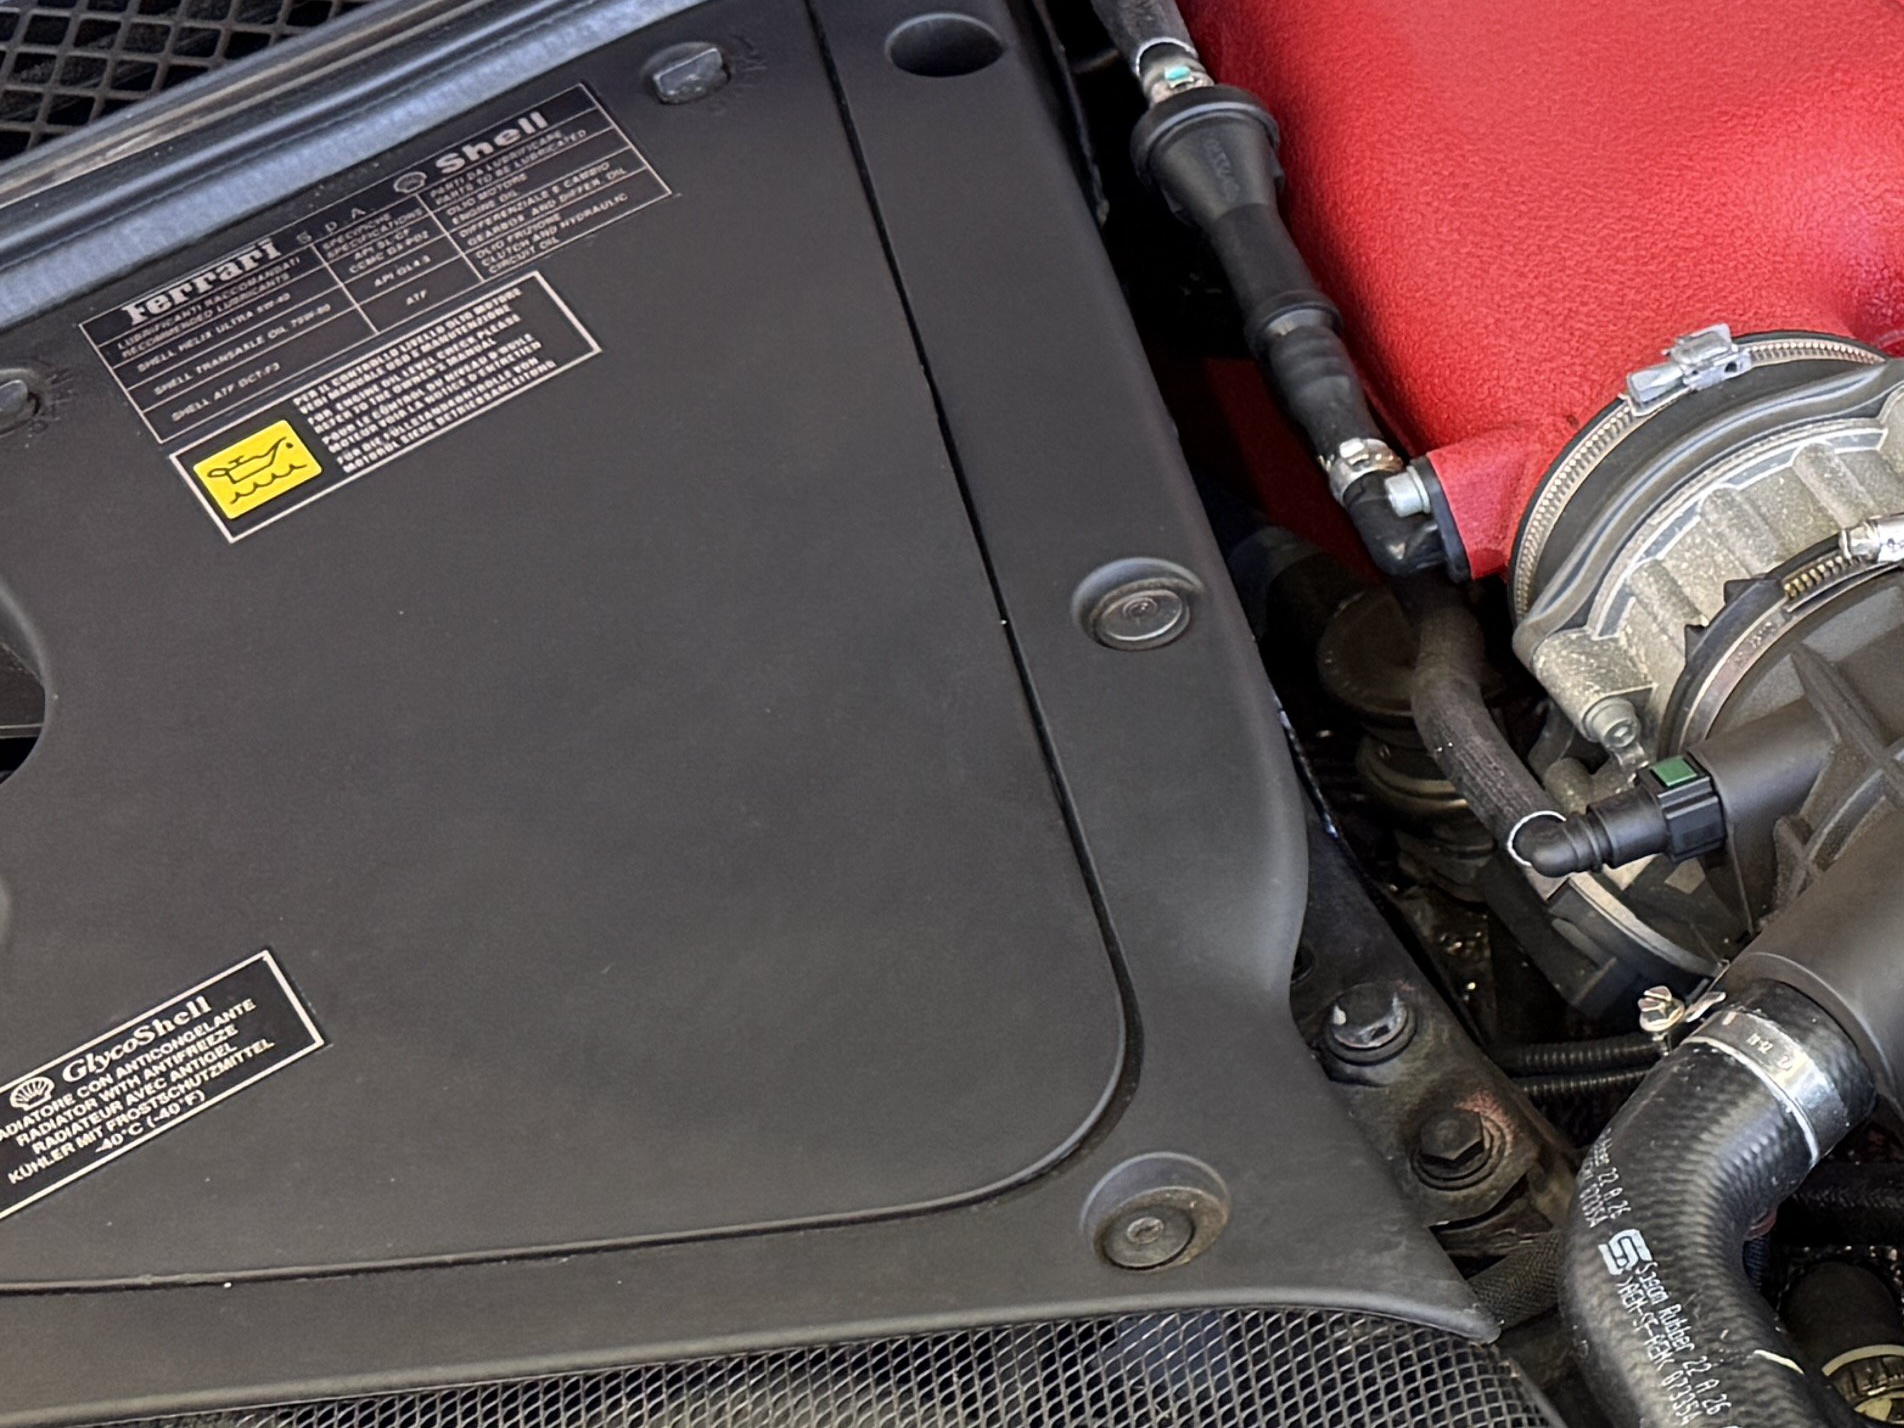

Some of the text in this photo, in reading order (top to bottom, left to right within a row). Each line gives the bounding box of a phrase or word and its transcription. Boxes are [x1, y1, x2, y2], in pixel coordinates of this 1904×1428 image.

[123, 238, 279, 324] Ferrari
[435, 112, 547, 173] Shell
[136, 349, 176, 372] SHELL
[215, 310, 254, 334] ULTRA
[153, 372, 192, 395] SHELL
[0, 999, 255, 1139] ADIATORE CON ANTICONGELANTE
[16, 1024, 238, 1146] RADIATOR WITH ANTIFREEZE
[62, 996, 210, 1082] GlycoShell
[7, 1039, 273, 1184] KÜHLER MIT FROSTSCHUTZMITTEL
[32, 1042, 237, 1154] RADIATEUR AVEC ANTIGEL
[1658, 1303, 1695, 1352] Rubber
[1682, 1355, 1712, 1377] 22
[1701, 1393, 1733, 1416] 26
